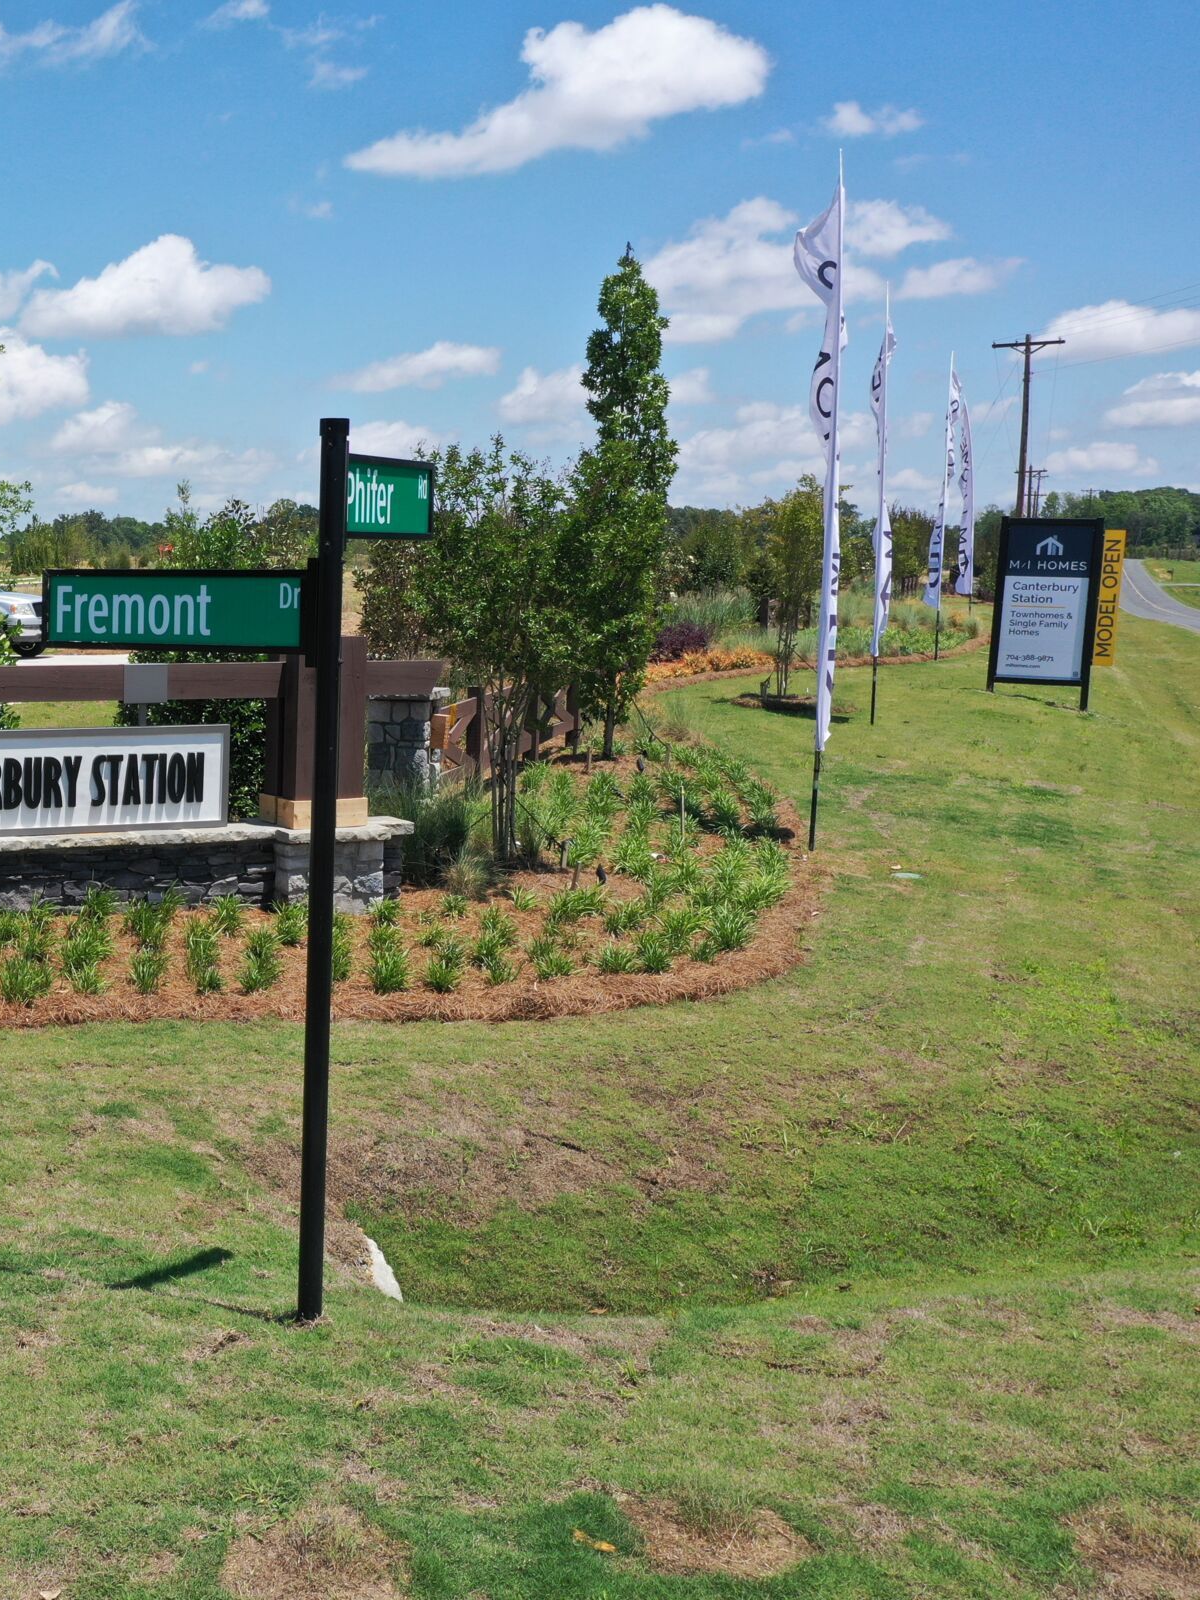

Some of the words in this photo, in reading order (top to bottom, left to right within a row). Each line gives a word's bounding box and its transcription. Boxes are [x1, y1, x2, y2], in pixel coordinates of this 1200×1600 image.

[347, 467, 394, 524] Phifer
[418, 474, 428, 499] Rd
[1037, 561, 1088, 571] HOMES
[1103, 539, 1121, 589] OPEN
[1012, 581, 1079, 594] Canterbury
[1011, 594, 1053, 604] Station
[56, 584, 211, 636] Fremont
[279, 582, 301, 609] Dr
[1011, 611, 1065, 619] Townhomes
[1066, 612, 1073, 620] &
[1009, 619, 1037, 628] Single
[1039, 620, 1069, 630] Family
[1095, 594, 1117, 657] MODEL
[1006, 654, 1054, 662] 704-388-9871
[91, 752, 205, 807] STATION
